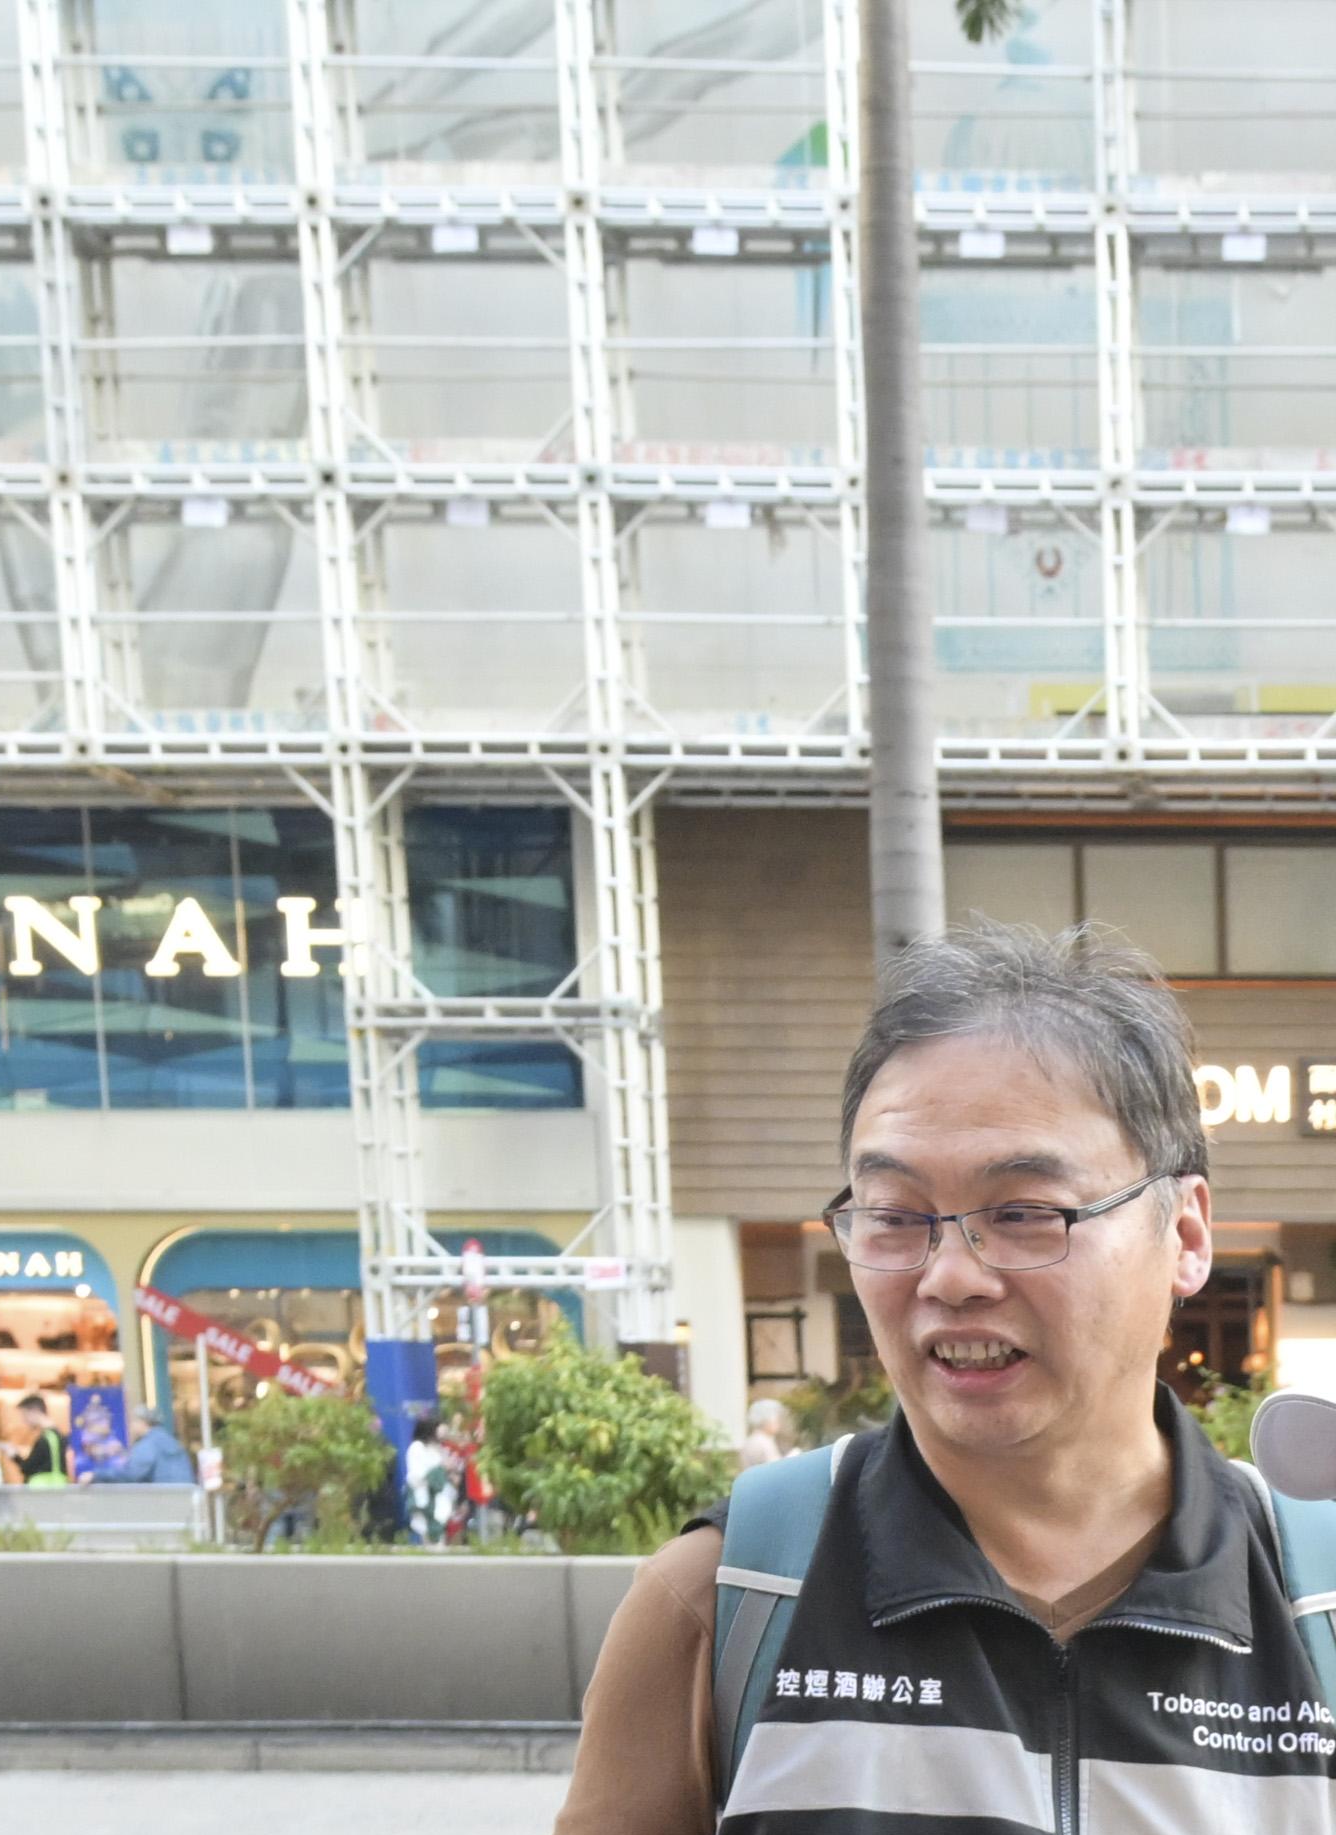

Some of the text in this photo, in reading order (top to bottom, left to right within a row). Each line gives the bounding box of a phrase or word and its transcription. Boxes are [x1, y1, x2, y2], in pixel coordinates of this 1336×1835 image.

[134, 1287, 328, 1397] SALE SALE SALE
[776, 1668, 944, 1706] 控煙酒辦公室
[1146, 1691, 1336, 1724] Tobacco and Alc
[1192, 1725, 1336, 1756] Control Office
